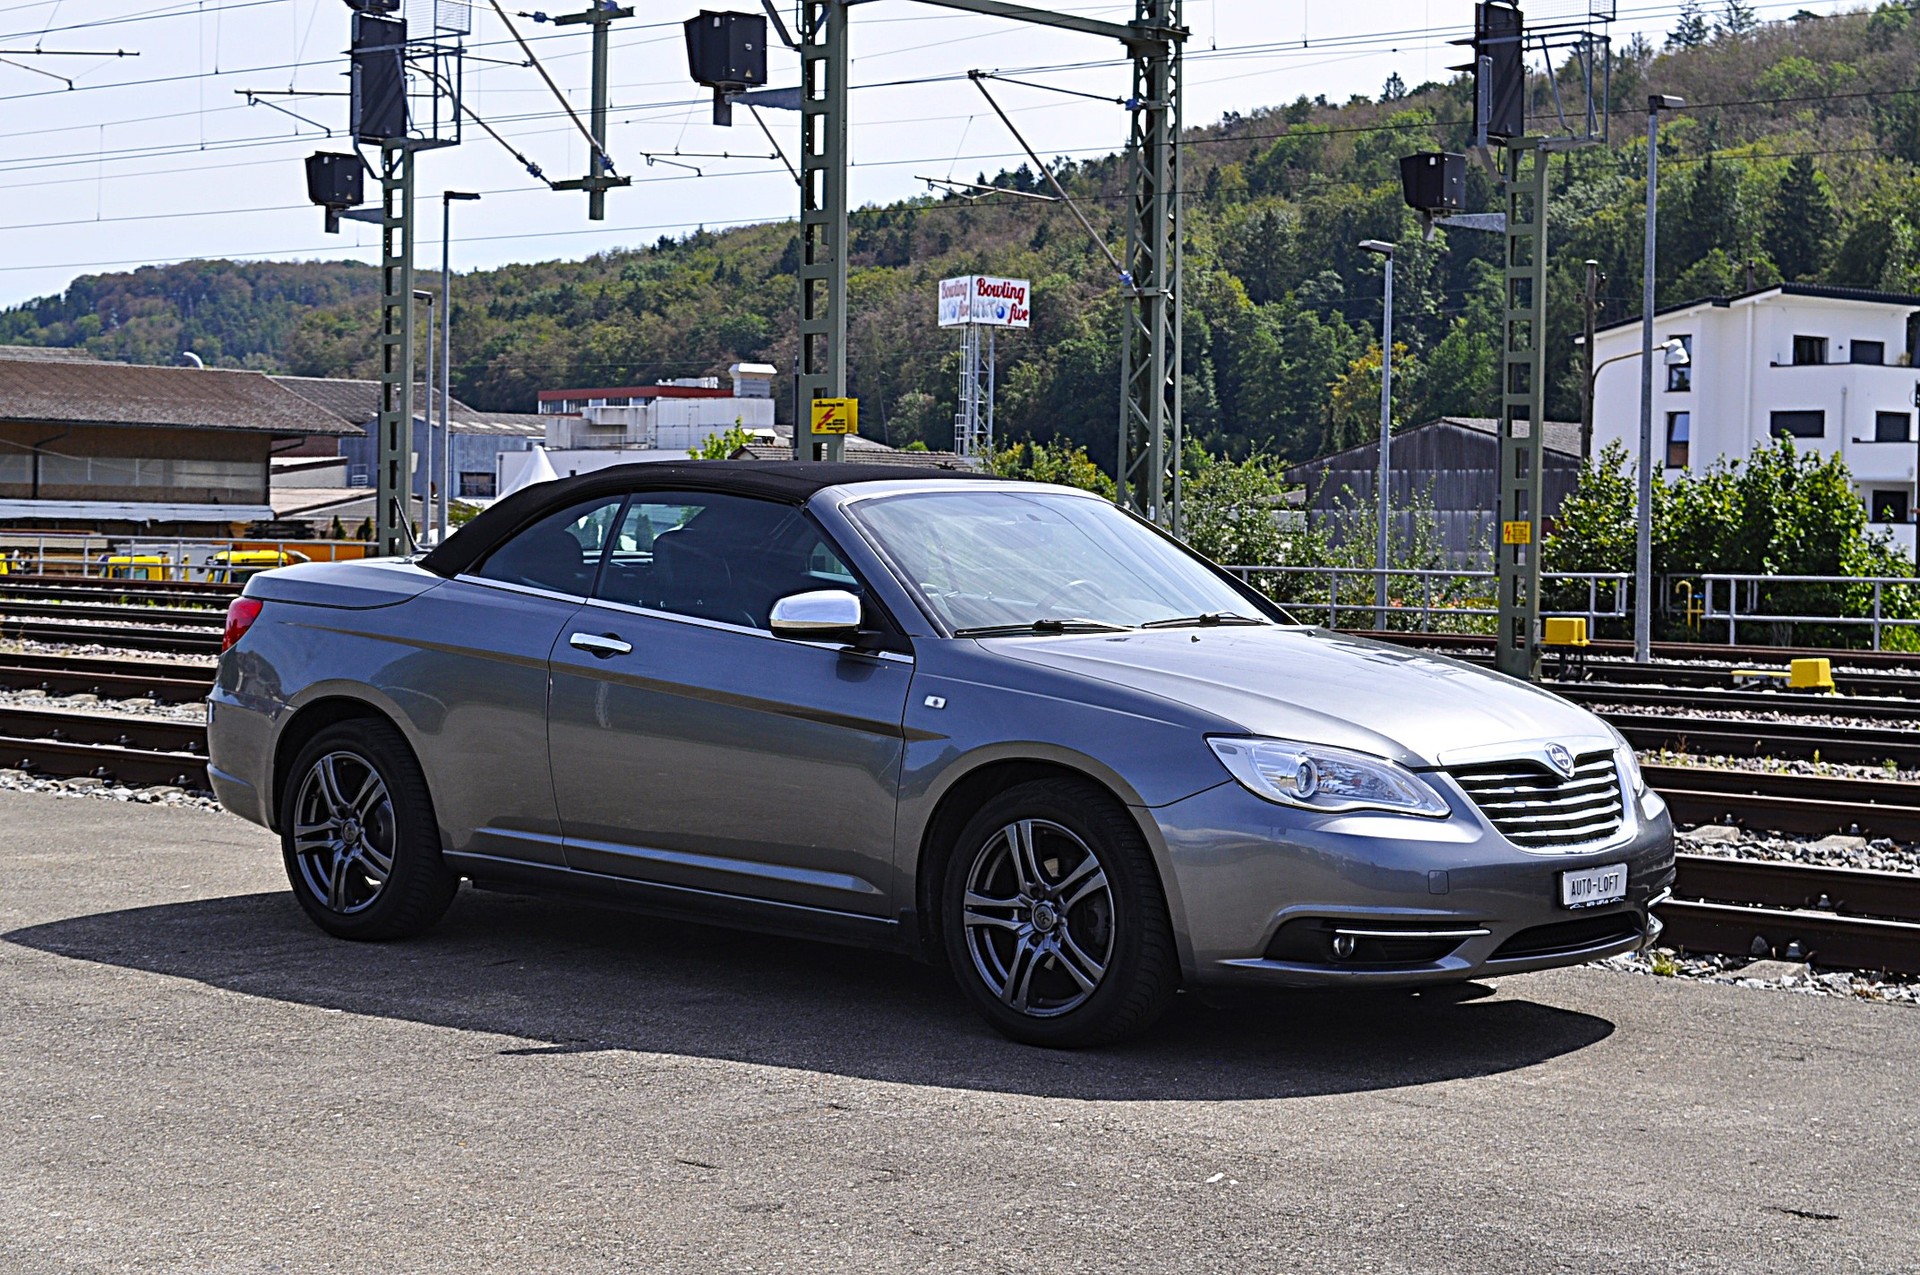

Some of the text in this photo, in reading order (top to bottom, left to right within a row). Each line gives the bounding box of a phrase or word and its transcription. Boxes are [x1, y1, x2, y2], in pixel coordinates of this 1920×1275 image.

[941, 281, 967, 301] Bowling
[976, 278, 1025, 305] Bowling
[1007, 303, 1029, 324] five
[1571, 873, 1619, 896] AUTO-LOFT
